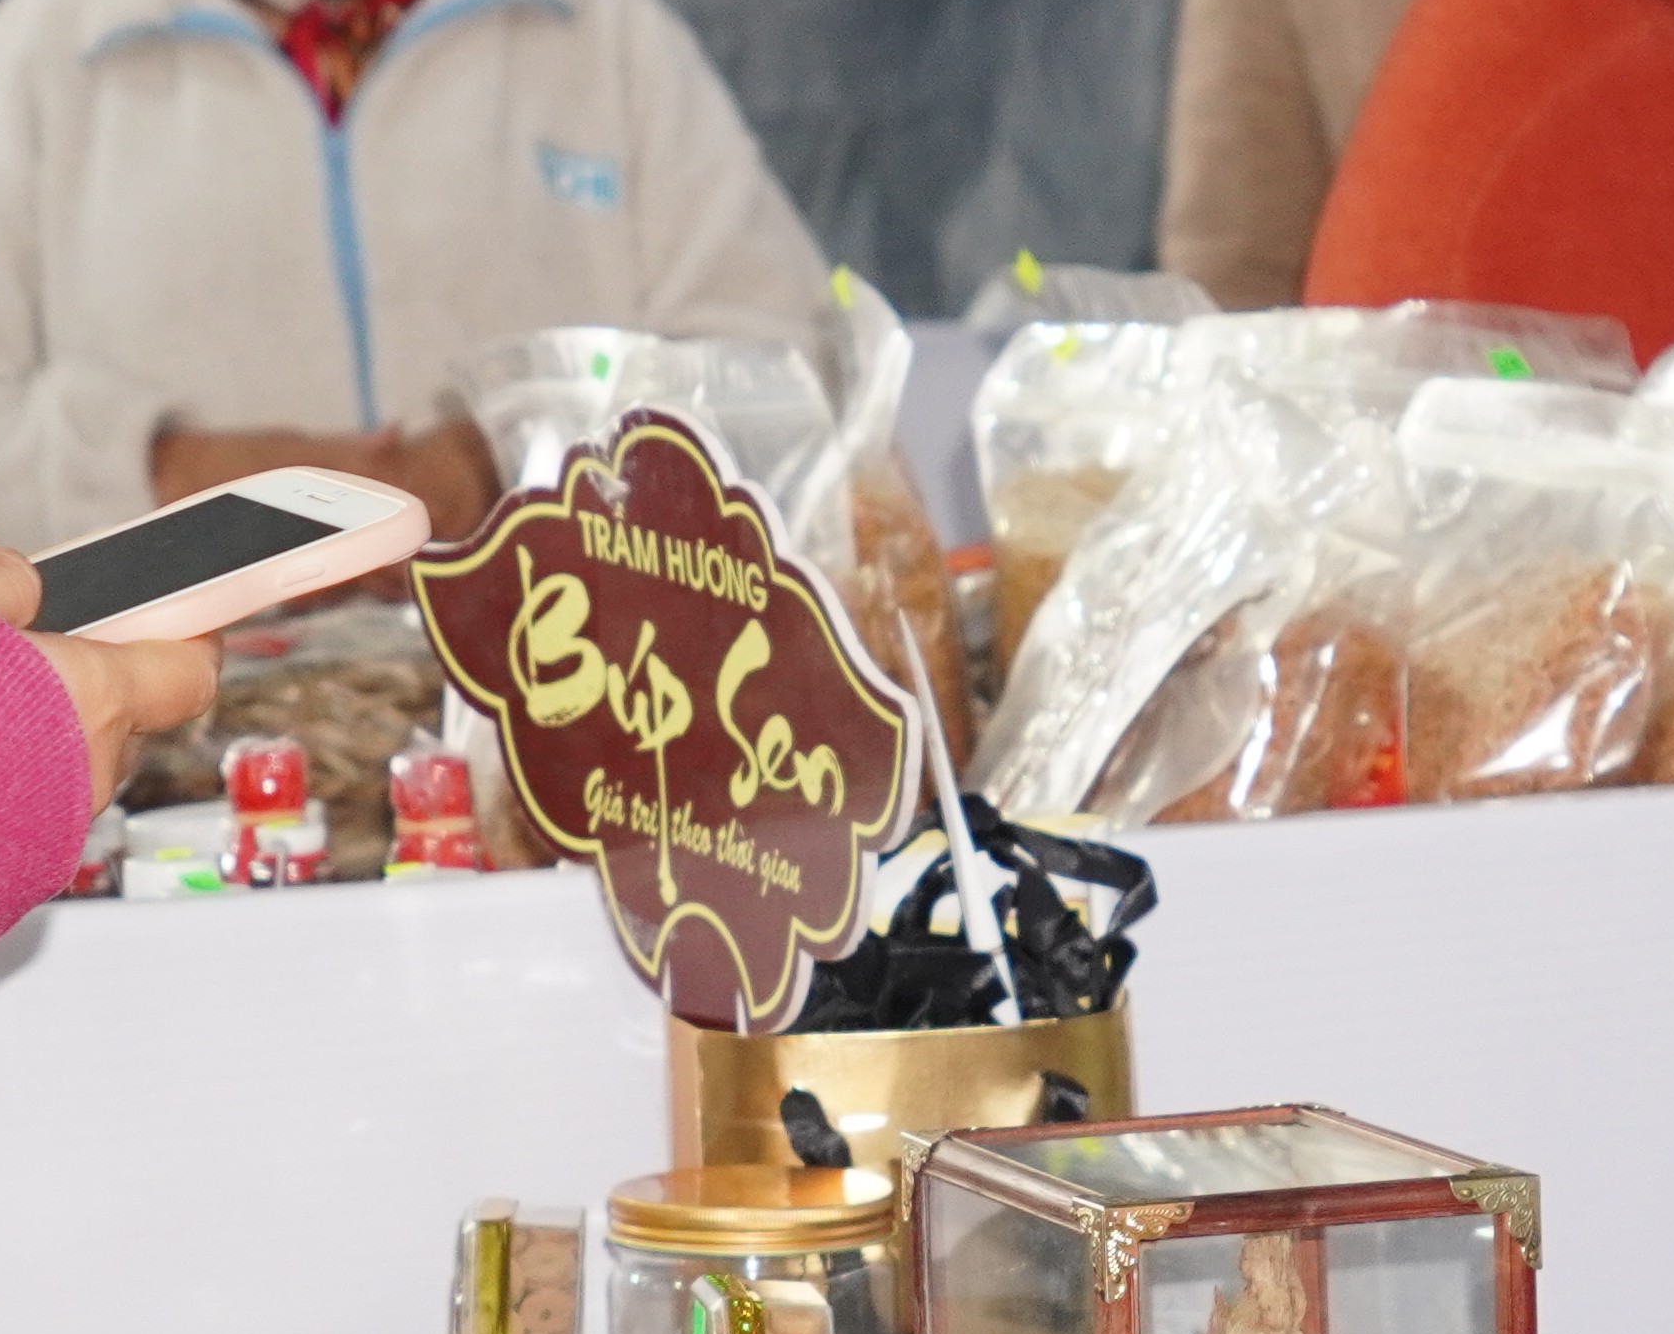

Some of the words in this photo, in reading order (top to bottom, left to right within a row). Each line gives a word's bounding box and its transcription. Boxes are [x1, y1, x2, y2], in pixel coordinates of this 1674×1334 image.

[577, 500, 660, 578] TRẦM
[663, 535, 769, 613] HƯƠNG
[508, 543, 694, 907] Búp
[716, 618, 845, 817] Sen
[759, 848, 803, 899] gian
